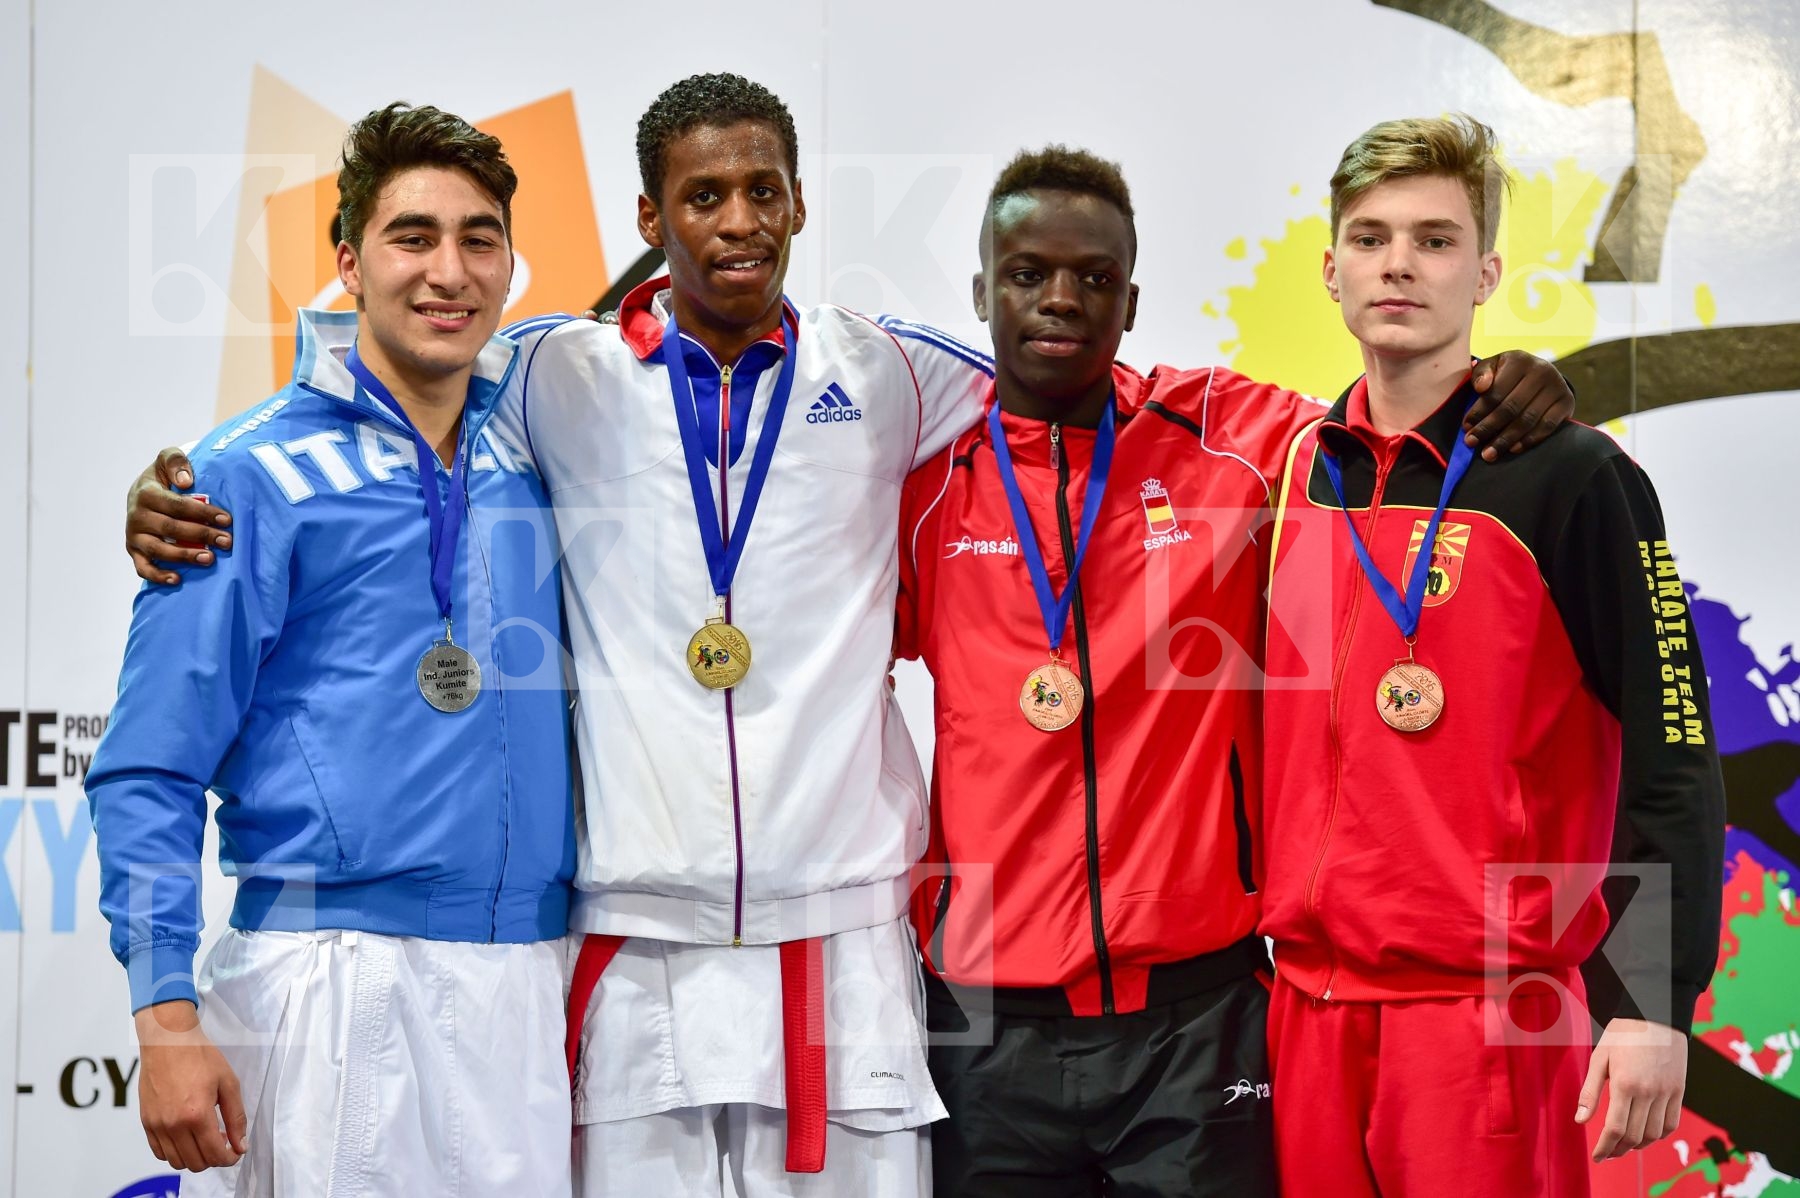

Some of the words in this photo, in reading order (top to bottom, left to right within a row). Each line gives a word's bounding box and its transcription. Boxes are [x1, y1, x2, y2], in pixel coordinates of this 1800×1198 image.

[806, 406, 862, 424] adidas
[1143, 530, 1192, 551] ESPAÑA
[437, 660, 458, 668] Male
[424, 672, 441, 681] Ind.
[443, 669, 475, 679] Juniors
[435, 680, 467, 690] Kumite
[1675, 665, 1705, 745] TEAM
